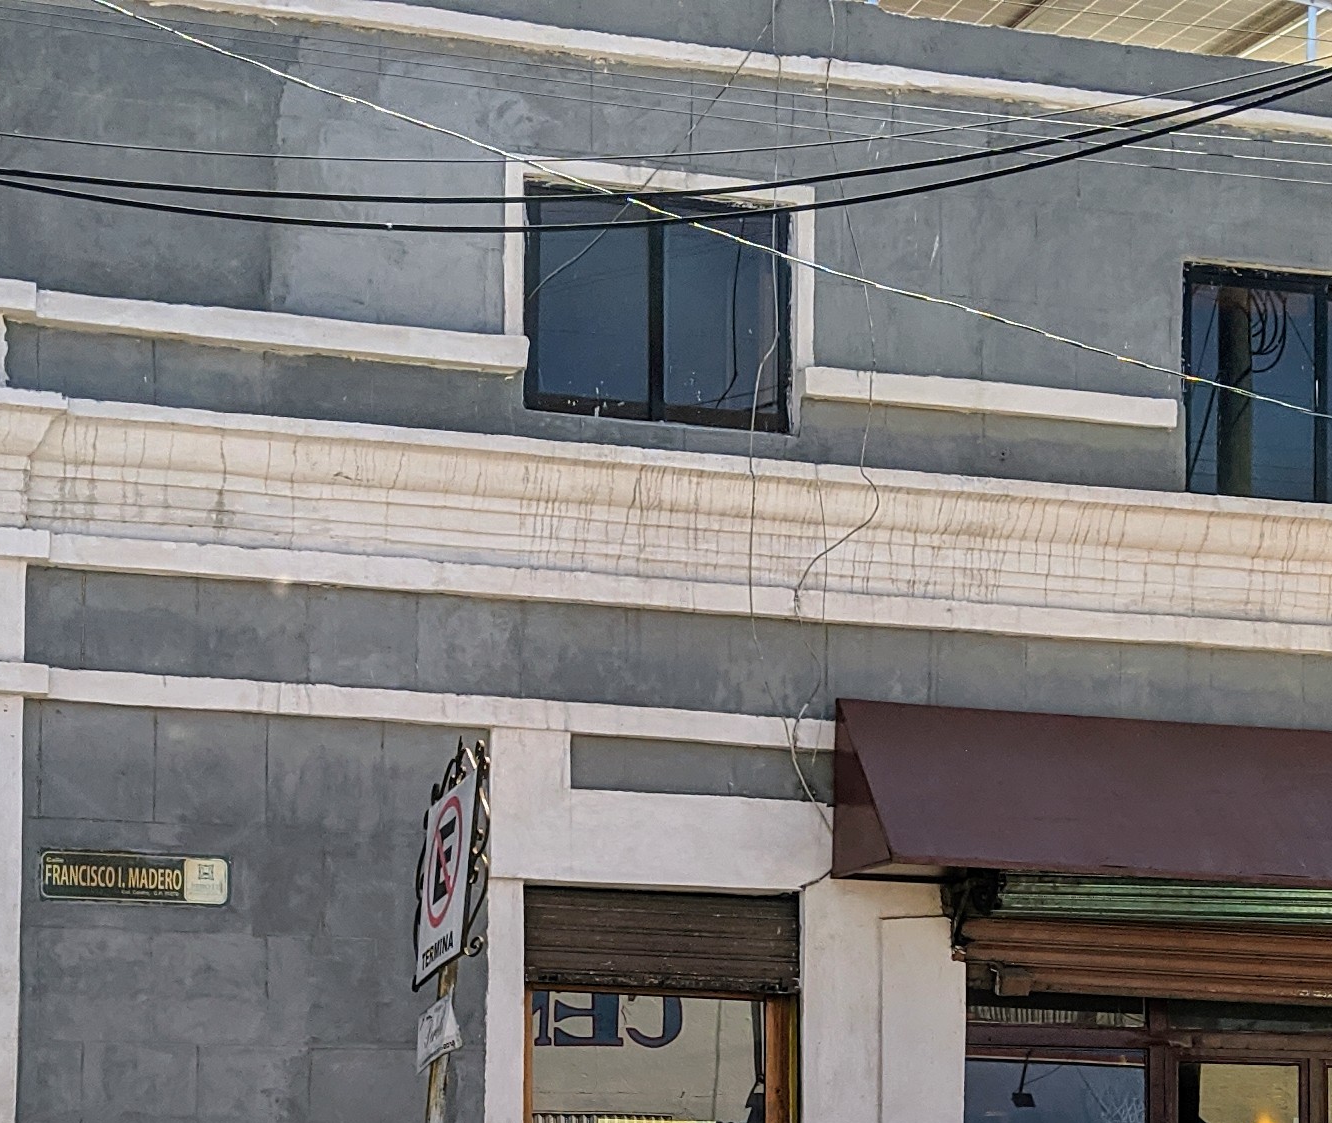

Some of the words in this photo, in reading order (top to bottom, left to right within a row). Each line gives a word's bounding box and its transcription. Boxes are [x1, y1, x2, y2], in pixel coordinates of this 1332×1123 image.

[44, 863, 116, 888] FRANCISCO
[128, 867, 182, 891] MADERO
[421, 931, 454, 971] TERMINA
